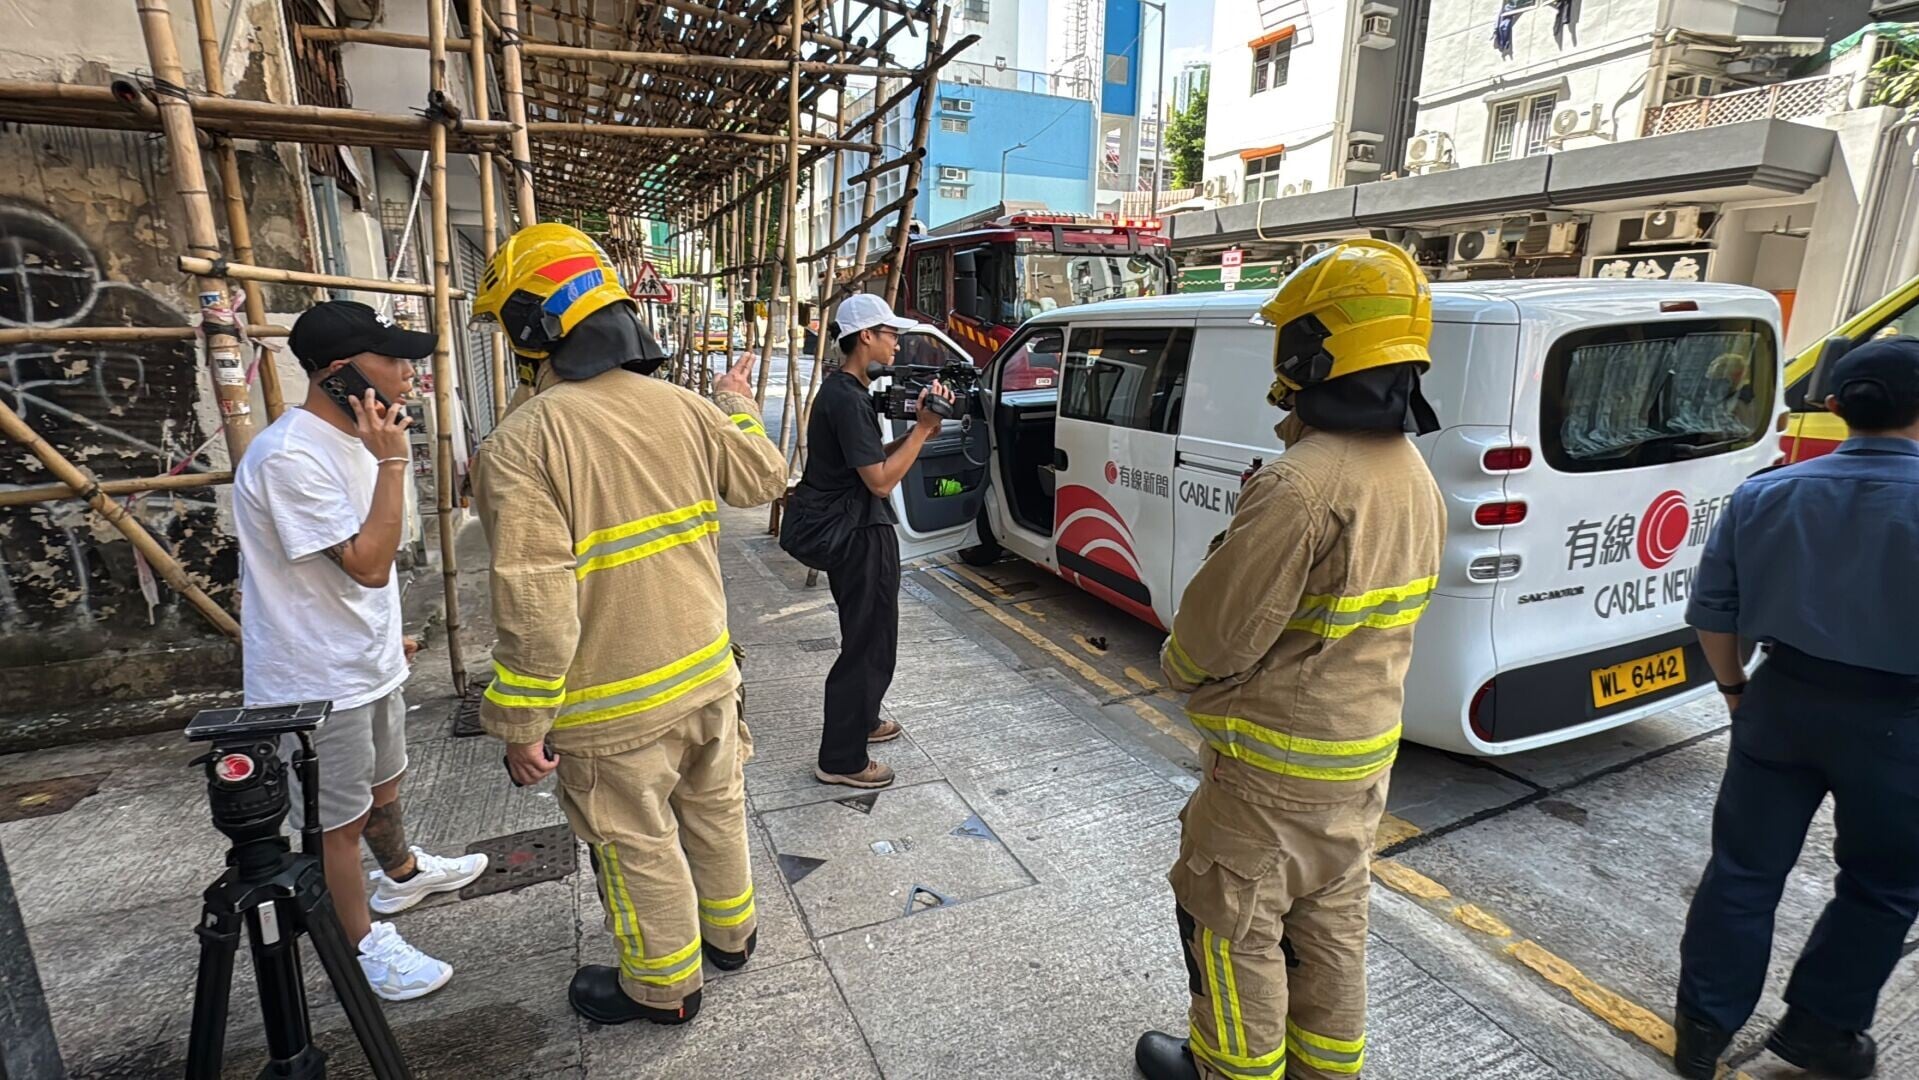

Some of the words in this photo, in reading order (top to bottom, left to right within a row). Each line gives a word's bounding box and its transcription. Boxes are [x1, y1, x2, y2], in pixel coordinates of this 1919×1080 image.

[1119, 465, 1169, 499] 有線新聞
[1179, 480, 1221, 512] CABLE
[1564, 513, 1635, 570] 有線
[1688, 495, 1733, 547] 新
[1595, 575, 1656, 618] CABLE
[1599, 671, 1626, 698] WL
[1631, 655, 1679, 688] 6442
